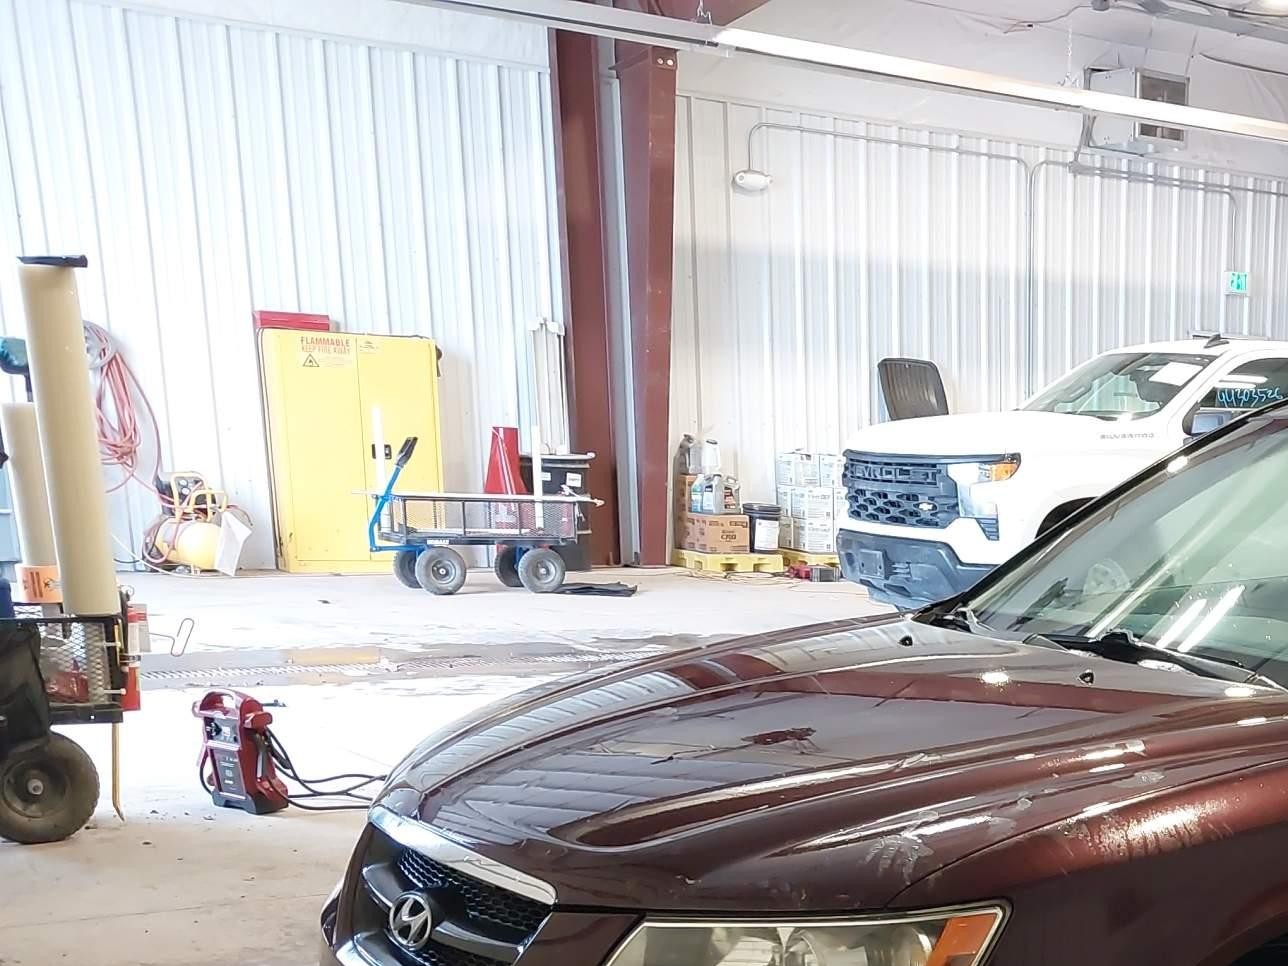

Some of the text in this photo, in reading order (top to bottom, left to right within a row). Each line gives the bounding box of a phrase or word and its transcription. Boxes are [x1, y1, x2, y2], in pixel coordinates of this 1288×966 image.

[300, 336, 350, 347] FLAMMABLE
[318, 346, 331, 354] FIRE
[333, 346, 351, 355] AWAY
[1217, 387, 1284, 408] 44303526
